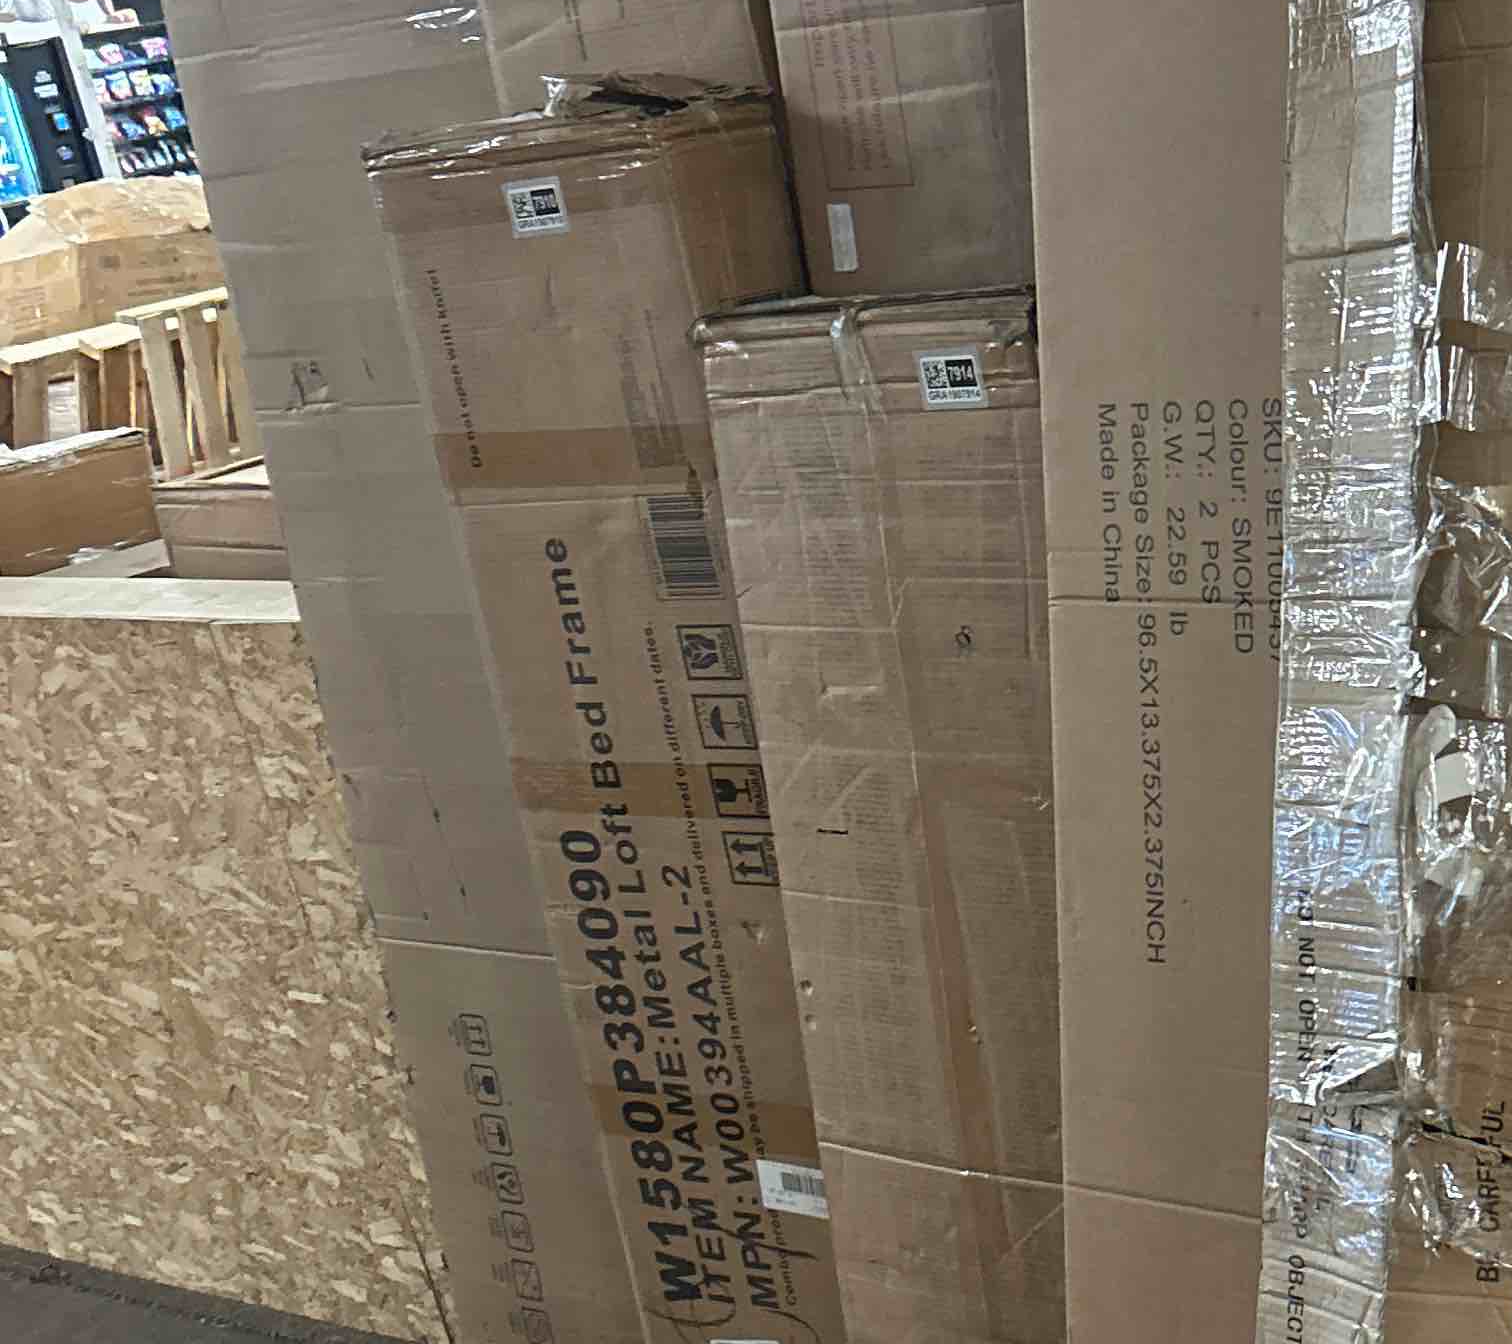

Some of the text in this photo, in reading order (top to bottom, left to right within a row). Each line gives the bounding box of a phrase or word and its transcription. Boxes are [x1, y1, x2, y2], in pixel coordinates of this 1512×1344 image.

[946, 364, 974, 383] 7914
[1096, 403, 1122, 603] Made in China
[1161, 401, 1188, 636] G.W.: 22.59 lb
[1198, 499, 1217, 517] 2
[1225, 398, 1256, 654] Colour: SMOKED
[539, 535, 599, 689] Frame
[1199, 540, 1220, 605] PCS
[1124, 402, 1167, 964] Package Size: 96.5X13.375X2.375INCH
[575, 698, 623, 792] Bed
[597, 799, 647, 897] Loft
[1296, 936, 1316, 980] NOT
[557, 823, 702, 1305] W1580P384090
[659, 860, 755, 1187] W00394AAL-2
[1297, 998, 1315, 1062] OPEN
[685, 1193, 736, 1305] ITEM
[730, 1194, 781, 1312] MPN:
